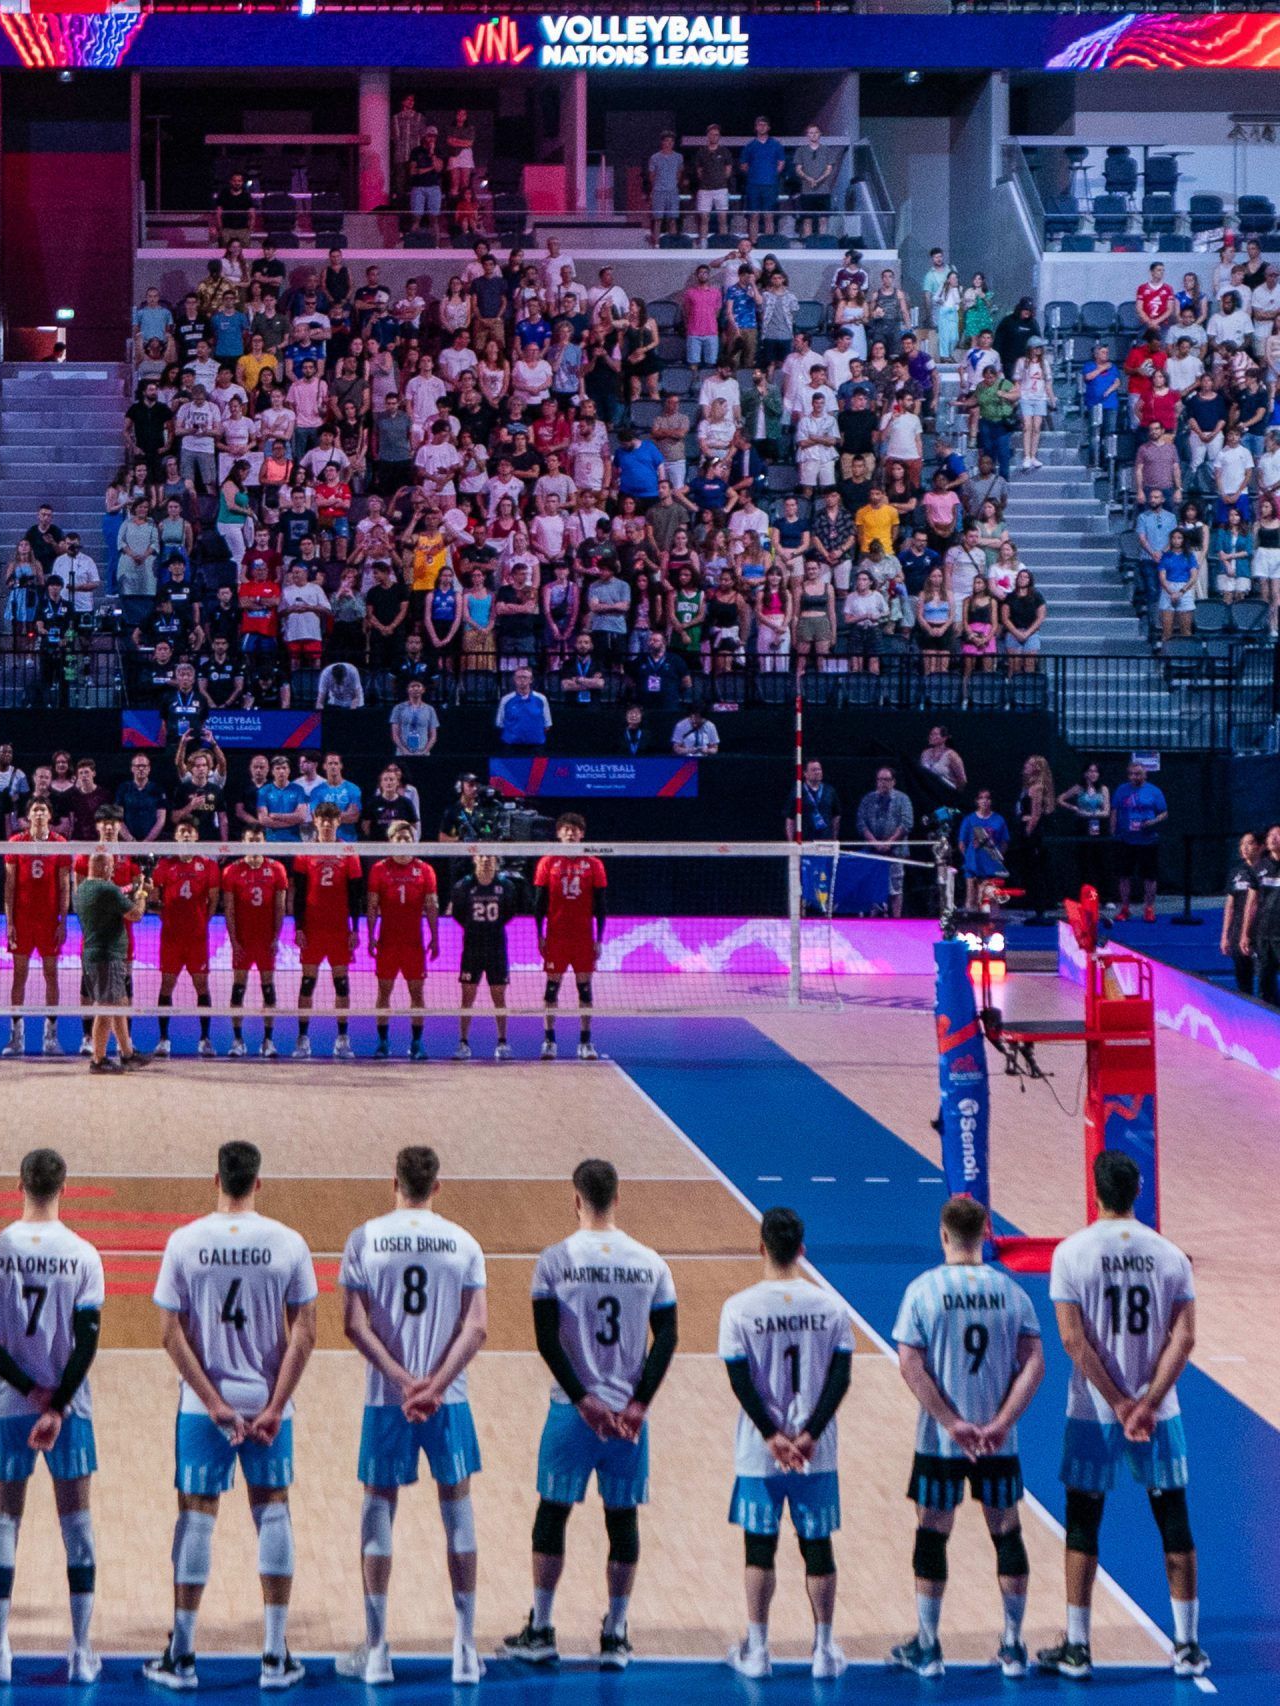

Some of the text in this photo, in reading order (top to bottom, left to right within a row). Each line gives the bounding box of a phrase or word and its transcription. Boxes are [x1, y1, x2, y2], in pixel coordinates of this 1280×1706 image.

[541, 15, 749, 43] VOLLEYBALL
[462, 15, 534, 63] VNL
[542, 45, 749, 66] NATIONS LEAGUE
[205, 716, 262, 724] VOLLEYBALL
[576, 764, 636, 772] VOLLEYBALL
[31, 860, 44, 878] 6
[321, 867, 333, 886] 2
[180, 880, 192, 899] 4
[397, 885, 406, 904] 1
[561, 876, 582, 896] 14
[251, 887, 263, 906] 3
[472, 903, 499, 922] 20
[960, 1116, 980, 1182] Senoh
[374, 1236, 457, 1254] LOSER BRUNO
[199, 1248, 272, 1266] GALLEGO
[1102, 1255, 1155, 1273] RAMOS
[563, 1266, 611, 1283] MARTINEZ
[403, 1264, 428, 1316] 8
[22, 1285, 49, 1337] 7
[220, 1278, 248, 1331] 4
[943, 1293, 1006, 1311] DANANI
[1103, 1284, 1150, 1336] 18
[595, 1296, 621, 1347] 3
[754, 1314, 828, 1335] SANCHEZ
[963, 1322, 989, 1375] 9
[783, 1344, 801, 1395] 1
